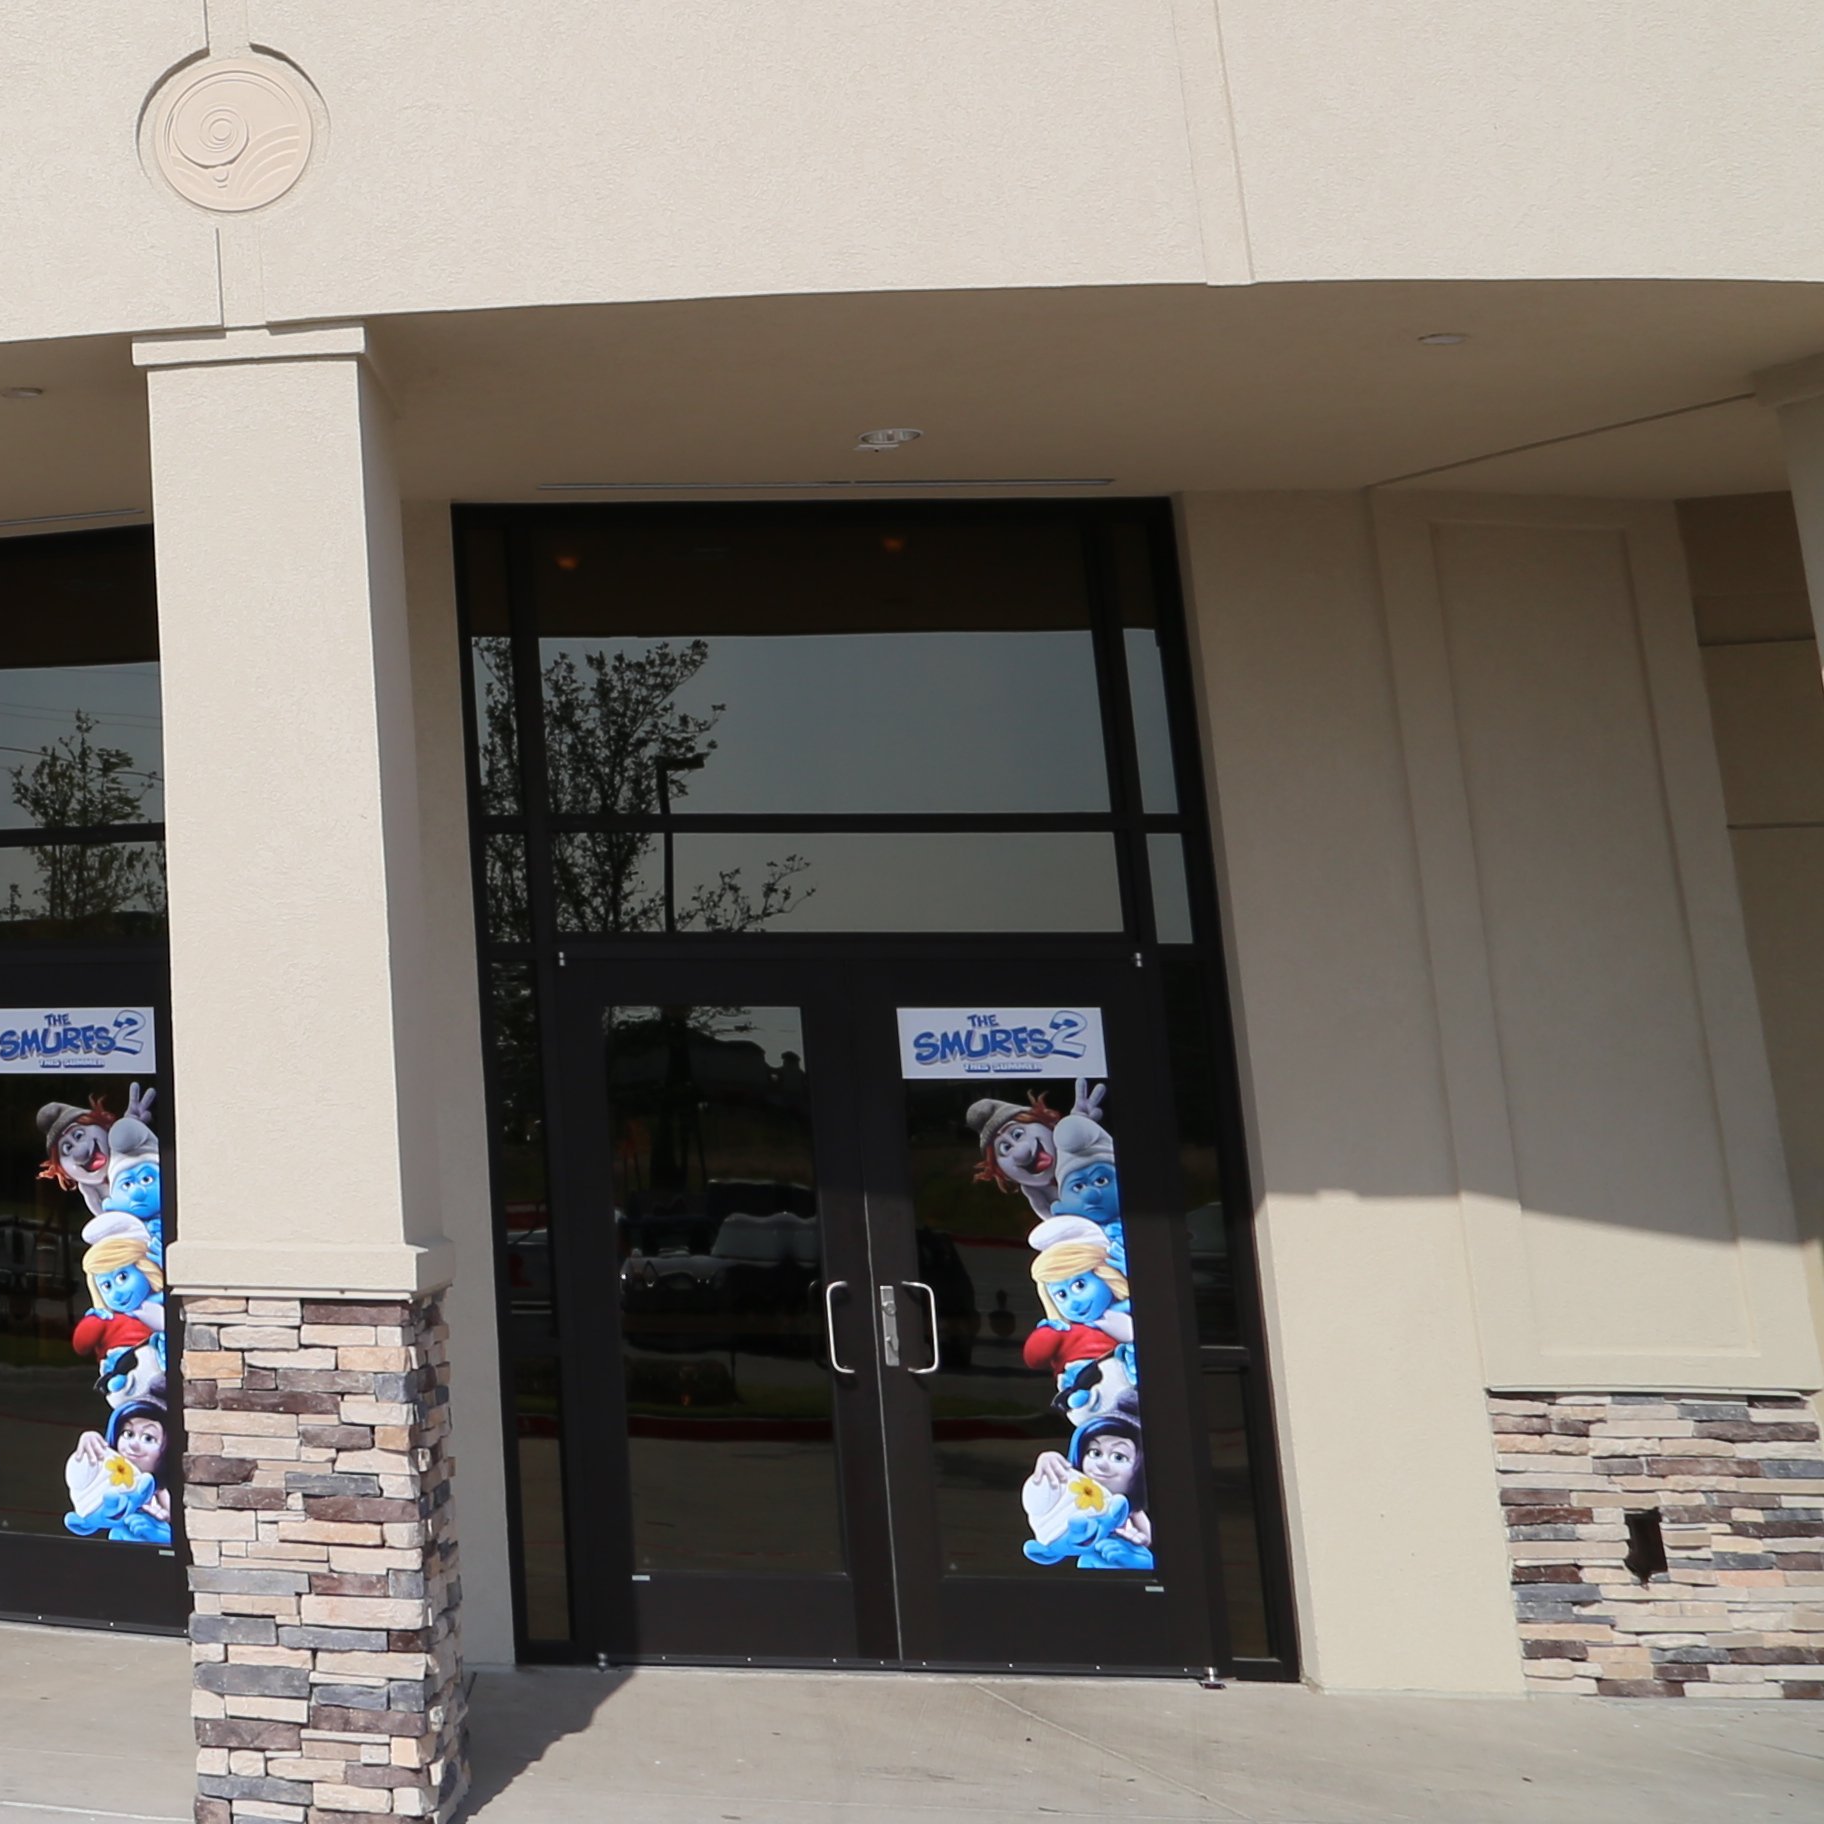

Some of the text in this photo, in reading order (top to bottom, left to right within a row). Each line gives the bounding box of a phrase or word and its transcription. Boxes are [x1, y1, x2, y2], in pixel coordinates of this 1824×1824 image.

[44, 1013, 72, 1026] THE
[113, 1009, 147, 1056] 2
[967, 1014, 1000, 1028] THE
[913, 1010, 1088, 1065] SMURFS 2
